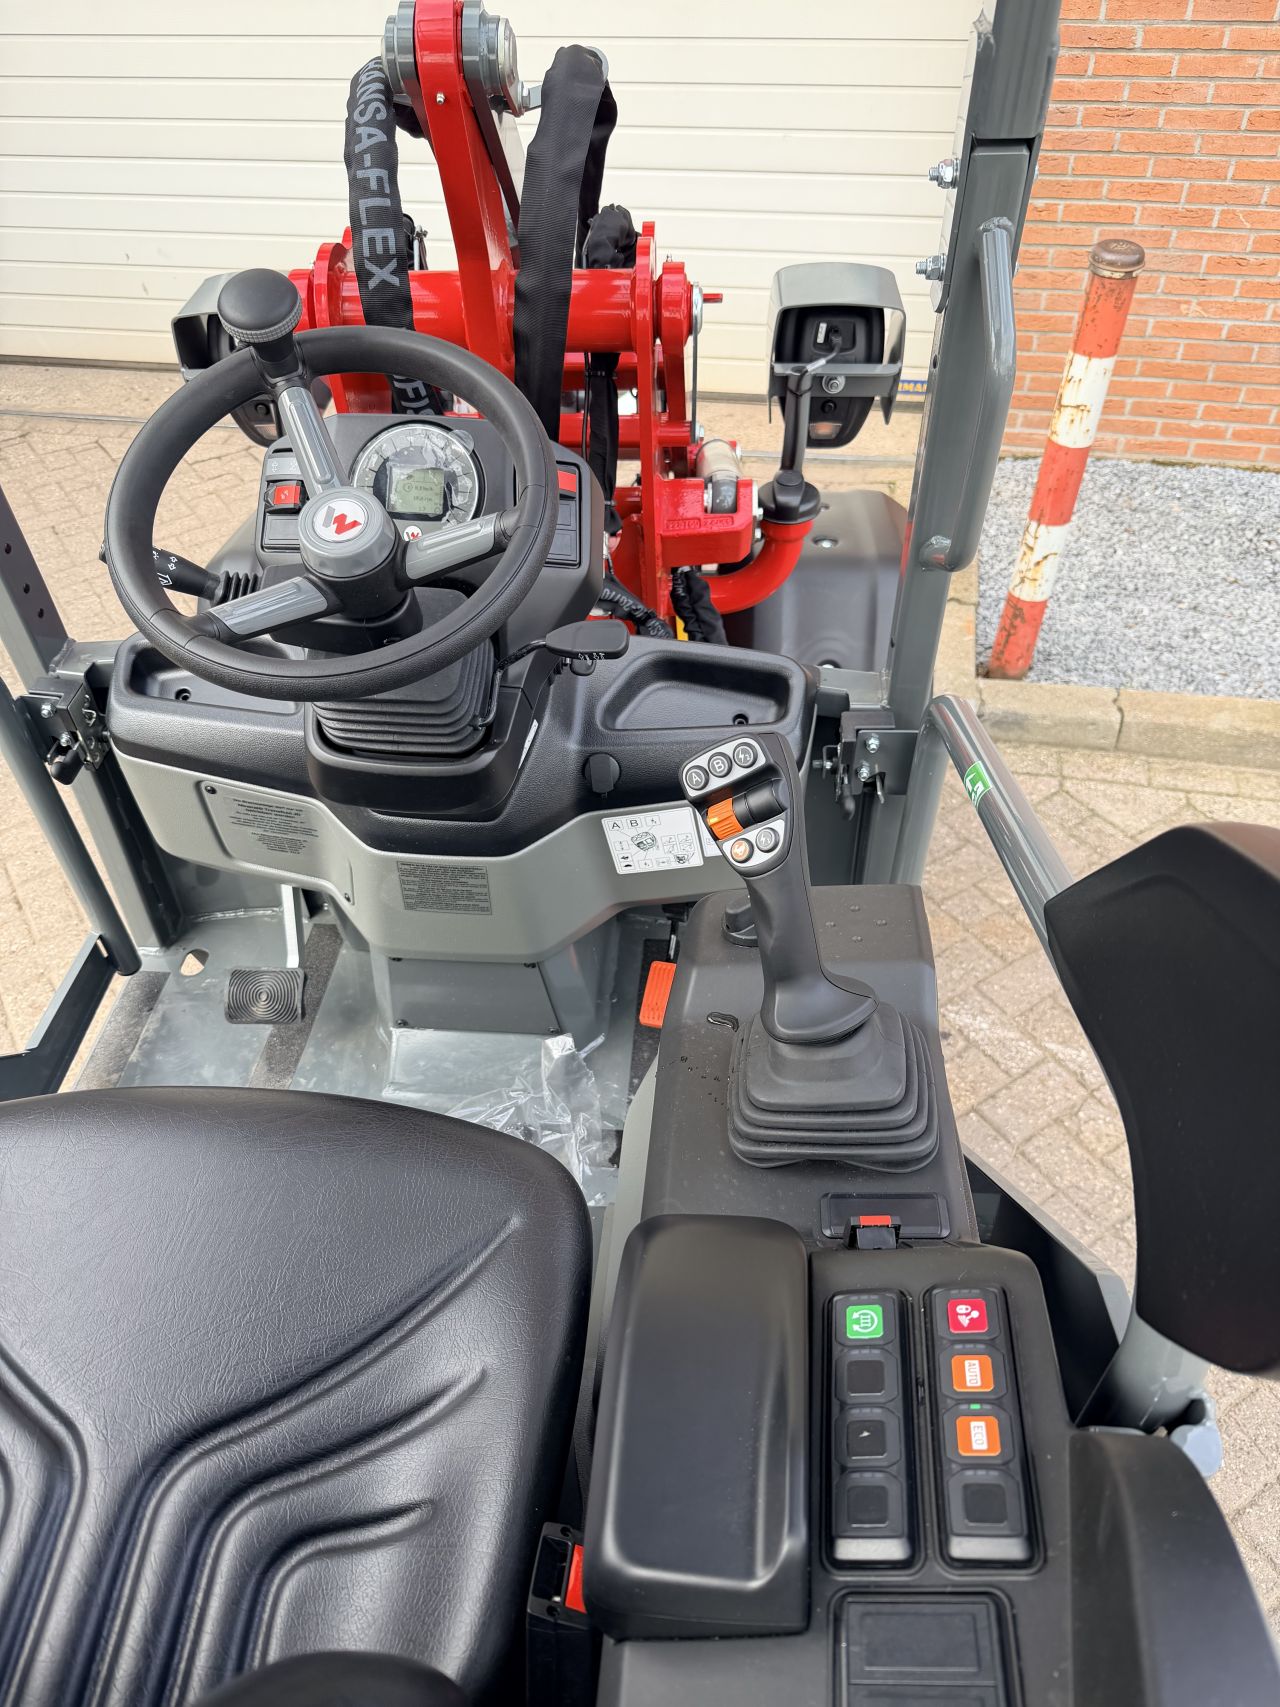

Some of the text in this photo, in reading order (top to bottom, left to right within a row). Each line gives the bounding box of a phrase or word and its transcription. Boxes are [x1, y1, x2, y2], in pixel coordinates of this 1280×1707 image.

[692, 772, 702, 785] A
[713, 759, 725, 772] B
[611, 819, 639, 830] A B
[967, 1361, 978, 1385] AUTO
[972, 1425, 984, 1446] ECO
